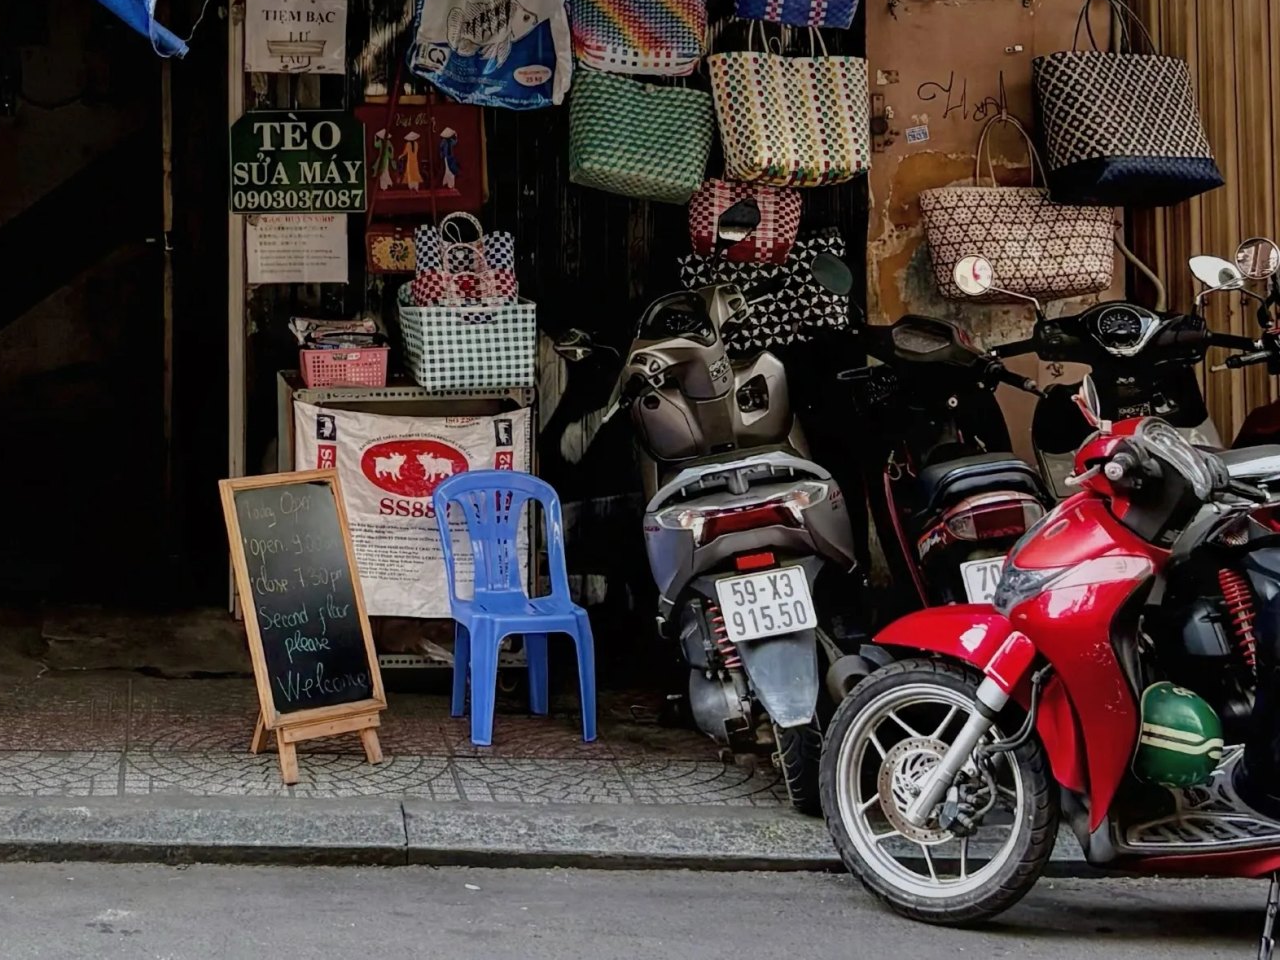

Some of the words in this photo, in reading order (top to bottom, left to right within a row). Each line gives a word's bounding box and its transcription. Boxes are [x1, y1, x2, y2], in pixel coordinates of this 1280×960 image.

[306, 10, 336, 25] BẠC
[253, 112, 342, 151] TÈO
[233, 152, 290, 186] SỬA
[298, 153, 363, 185] MÁY
[233, 189, 364, 209] 0903037087
[730, 573, 795, 607] 59-X3
[260, 601, 309, 630] Second
[732, 599, 808, 637] 915.50
[285, 629, 332, 664] please
[276, 661, 369, 702] Welcome
